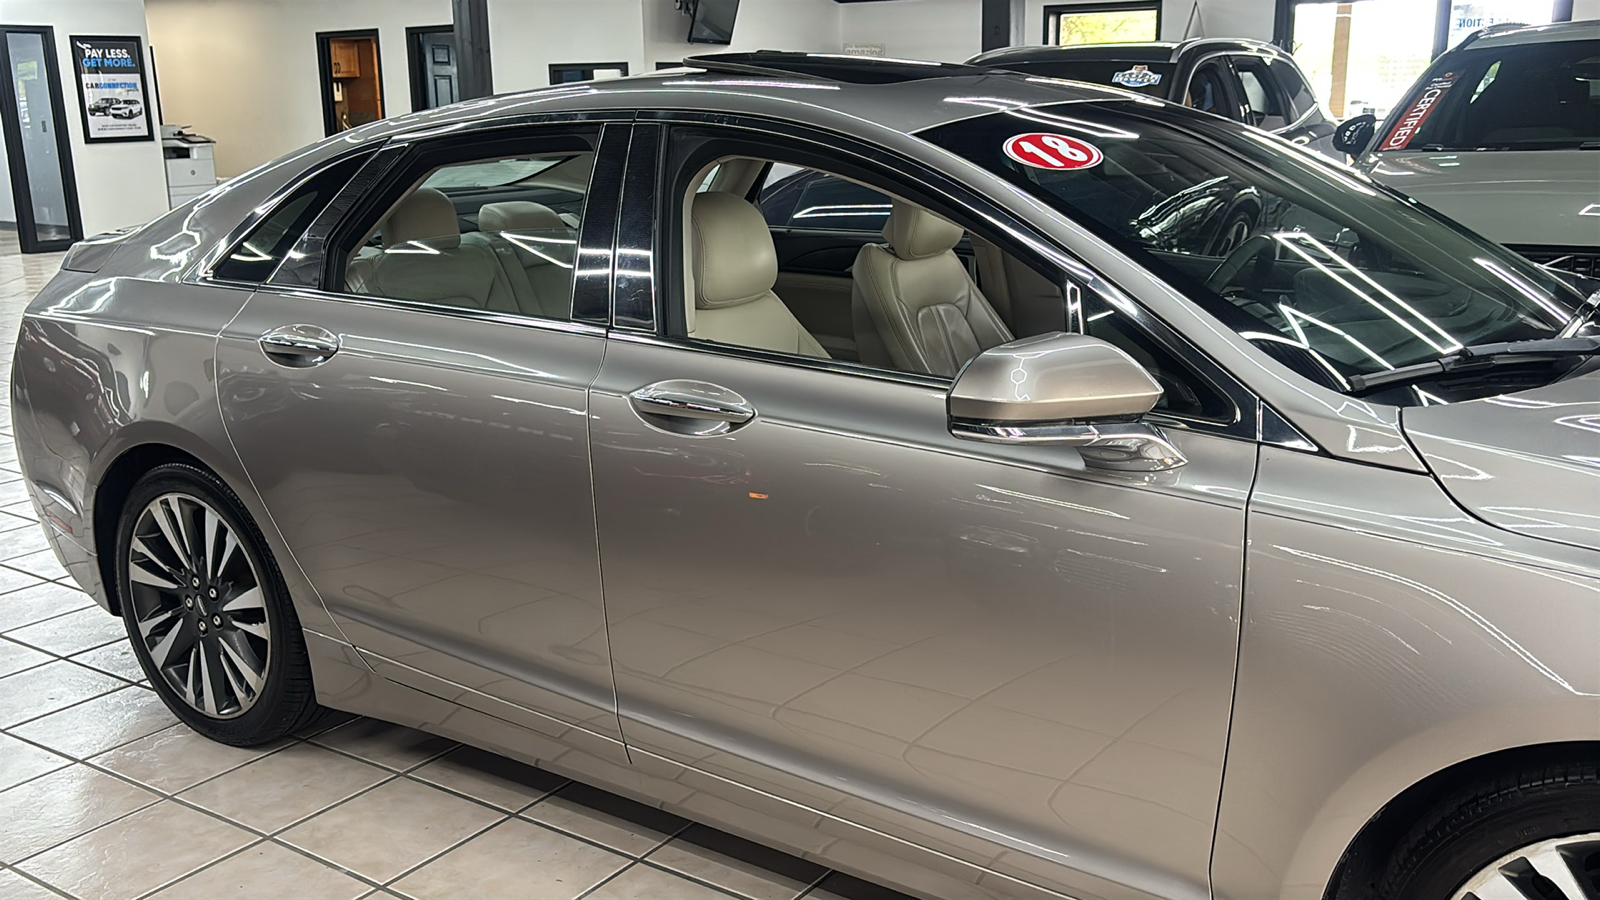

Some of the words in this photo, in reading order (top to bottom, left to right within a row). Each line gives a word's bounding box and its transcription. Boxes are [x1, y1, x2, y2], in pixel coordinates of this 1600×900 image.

[83, 58, 102, 67] GET
[104, 58, 136, 67] MORE.
[85, 49, 103, 58] PAY
[105, 49, 130, 58] LESS.
[1389, 89, 1442, 147] CERTIFIED
[1018, 135, 1088, 167] 18
